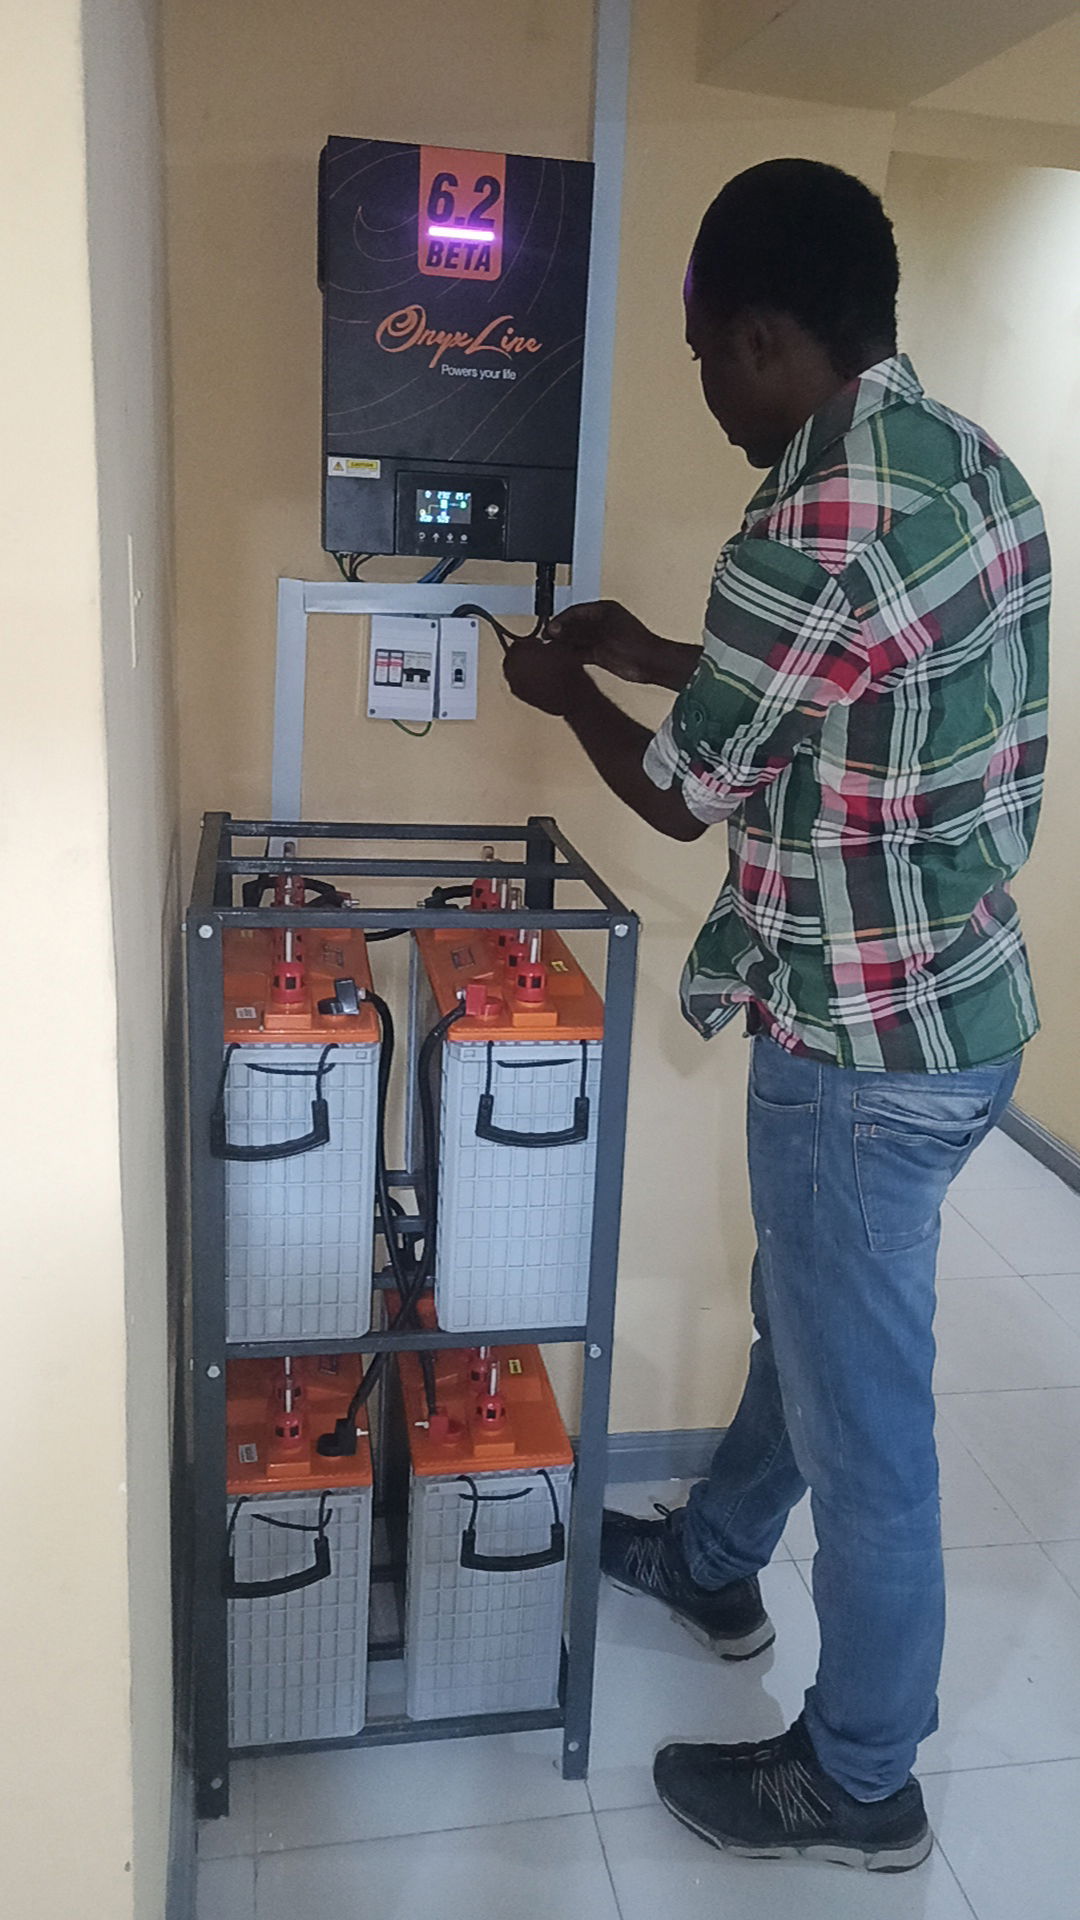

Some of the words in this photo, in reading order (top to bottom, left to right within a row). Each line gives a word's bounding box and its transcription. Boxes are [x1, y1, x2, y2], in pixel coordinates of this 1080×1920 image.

[427, 172, 501, 228] 6.2
[425, 240, 491, 272] BETA
[441, 363, 478, 378] Powers
[479, 368, 501, 380] your
[502, 368, 517, 380] life
